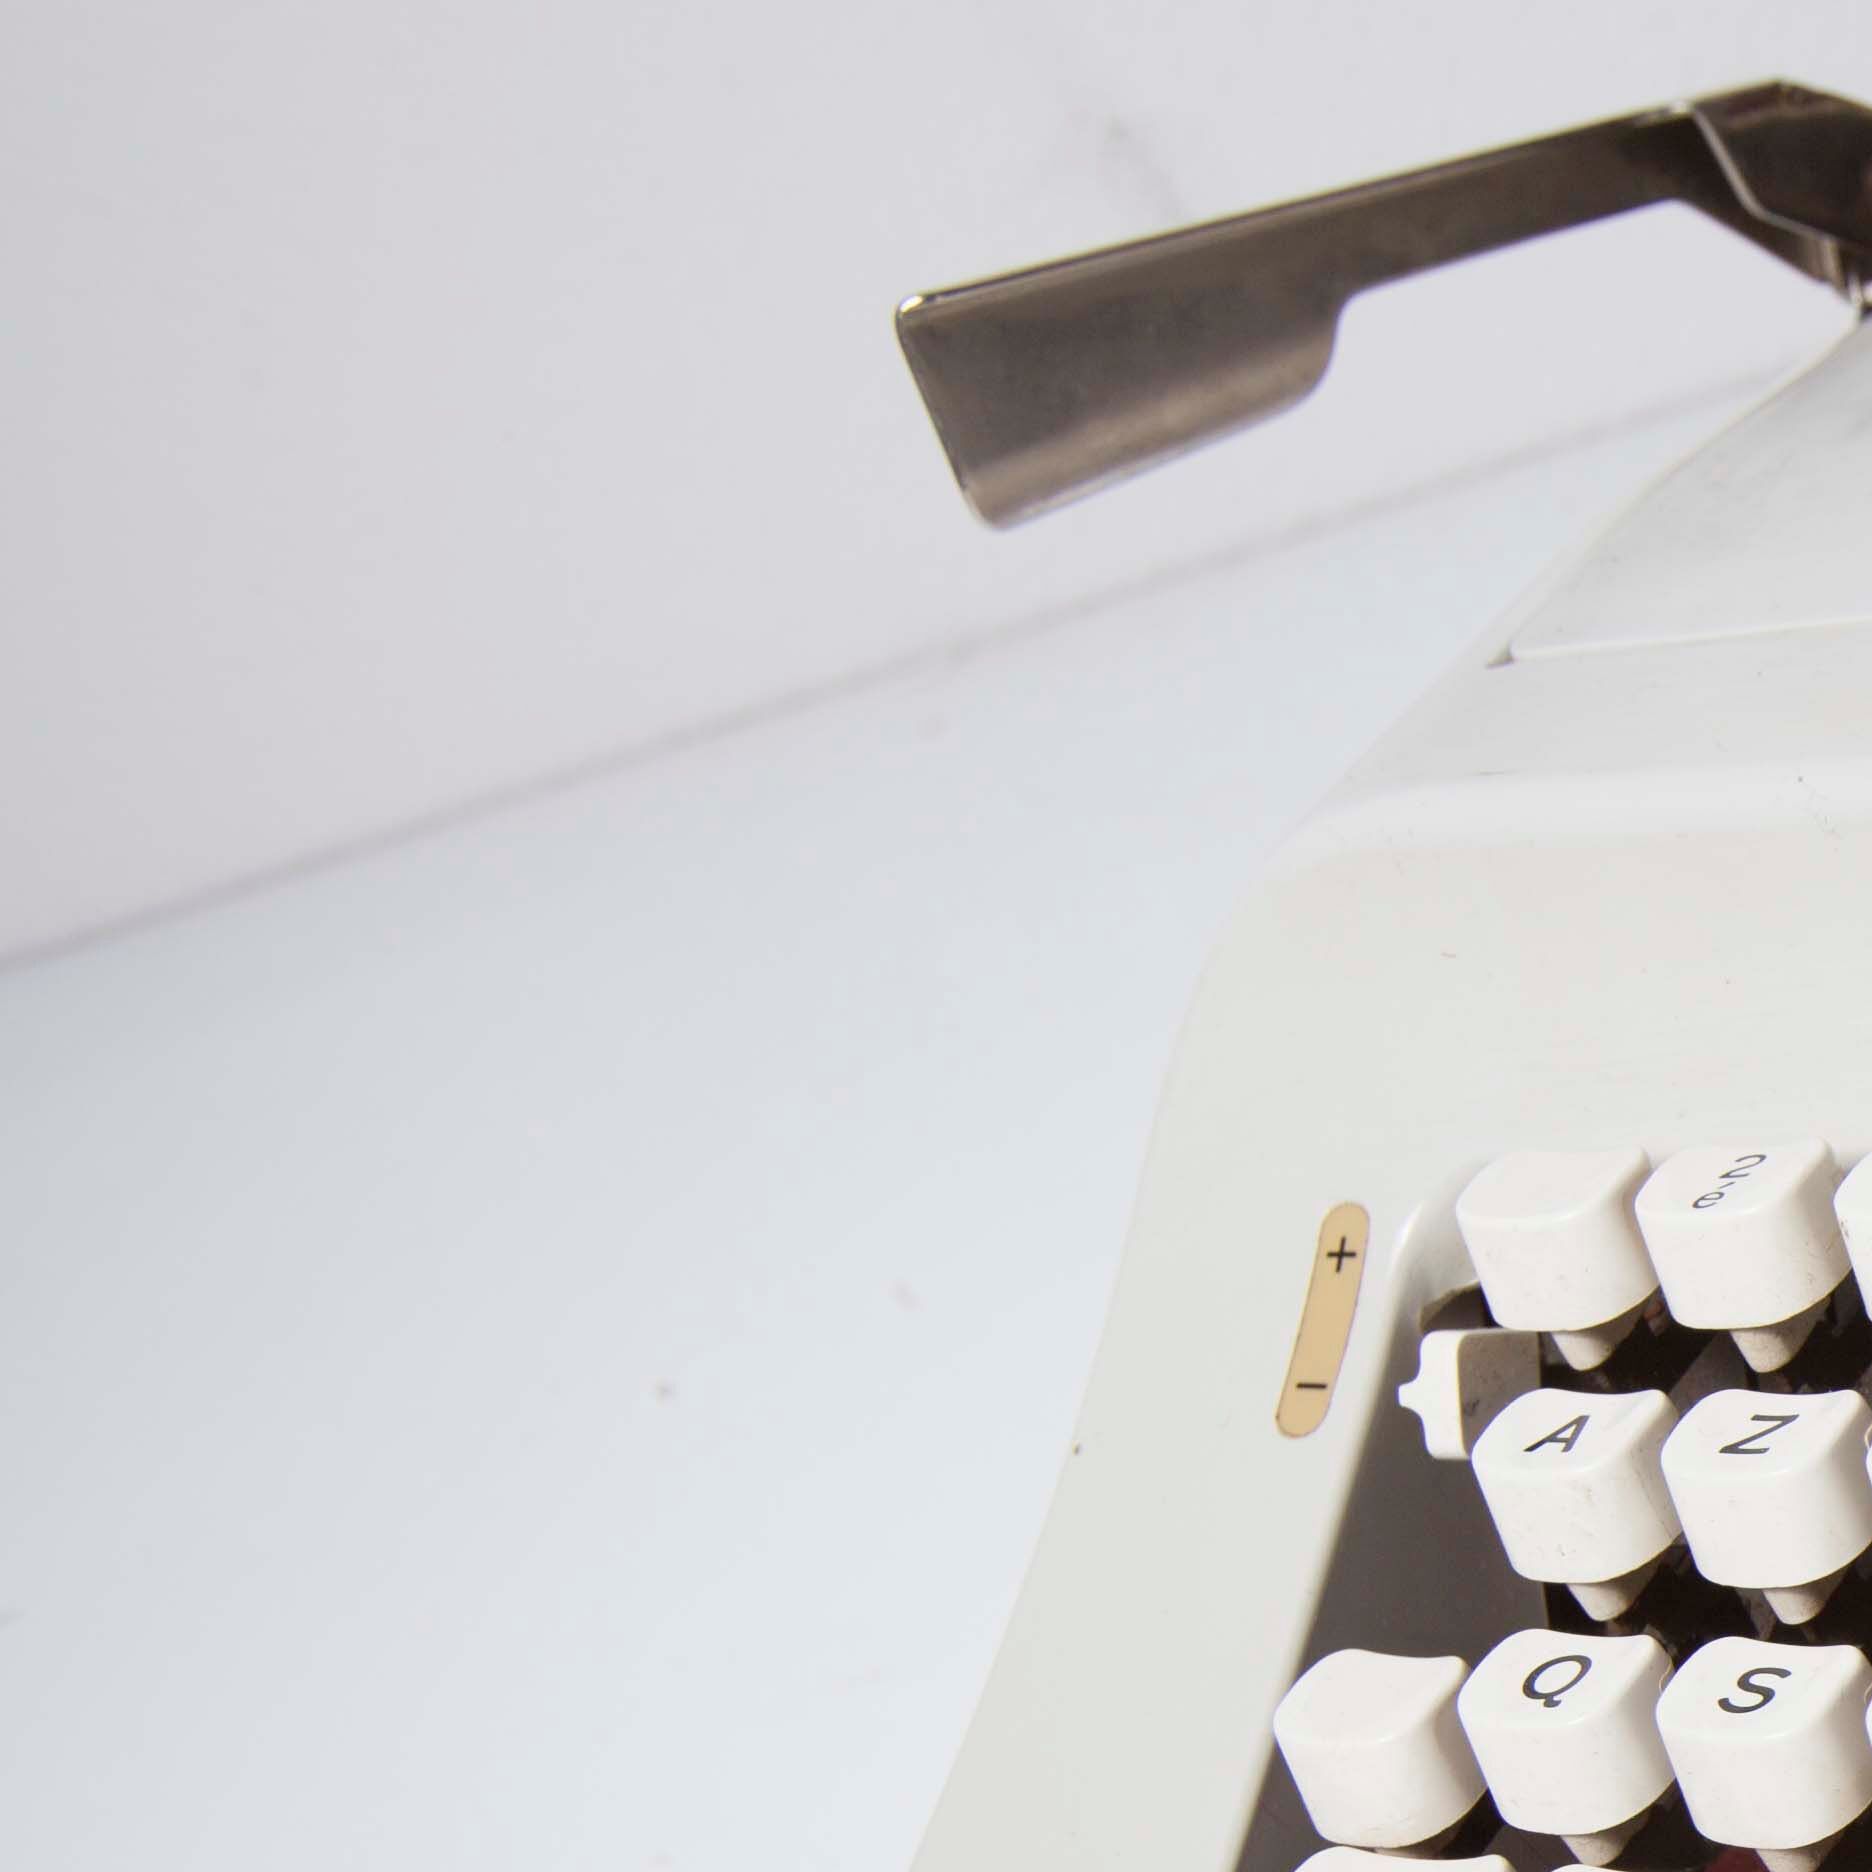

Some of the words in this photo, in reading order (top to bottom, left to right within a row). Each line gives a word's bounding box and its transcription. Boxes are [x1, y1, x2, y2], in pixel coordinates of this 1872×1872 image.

[1719, 1154, 1767, 1179] 2
[1692, 1181, 1735, 1209] é
[1523, 1415, 1590, 1453] A
[1718, 1414, 1800, 1455] Z
[1522, 1654, 1592, 1708] Q
[1717, 1667, 1792, 1714] S
